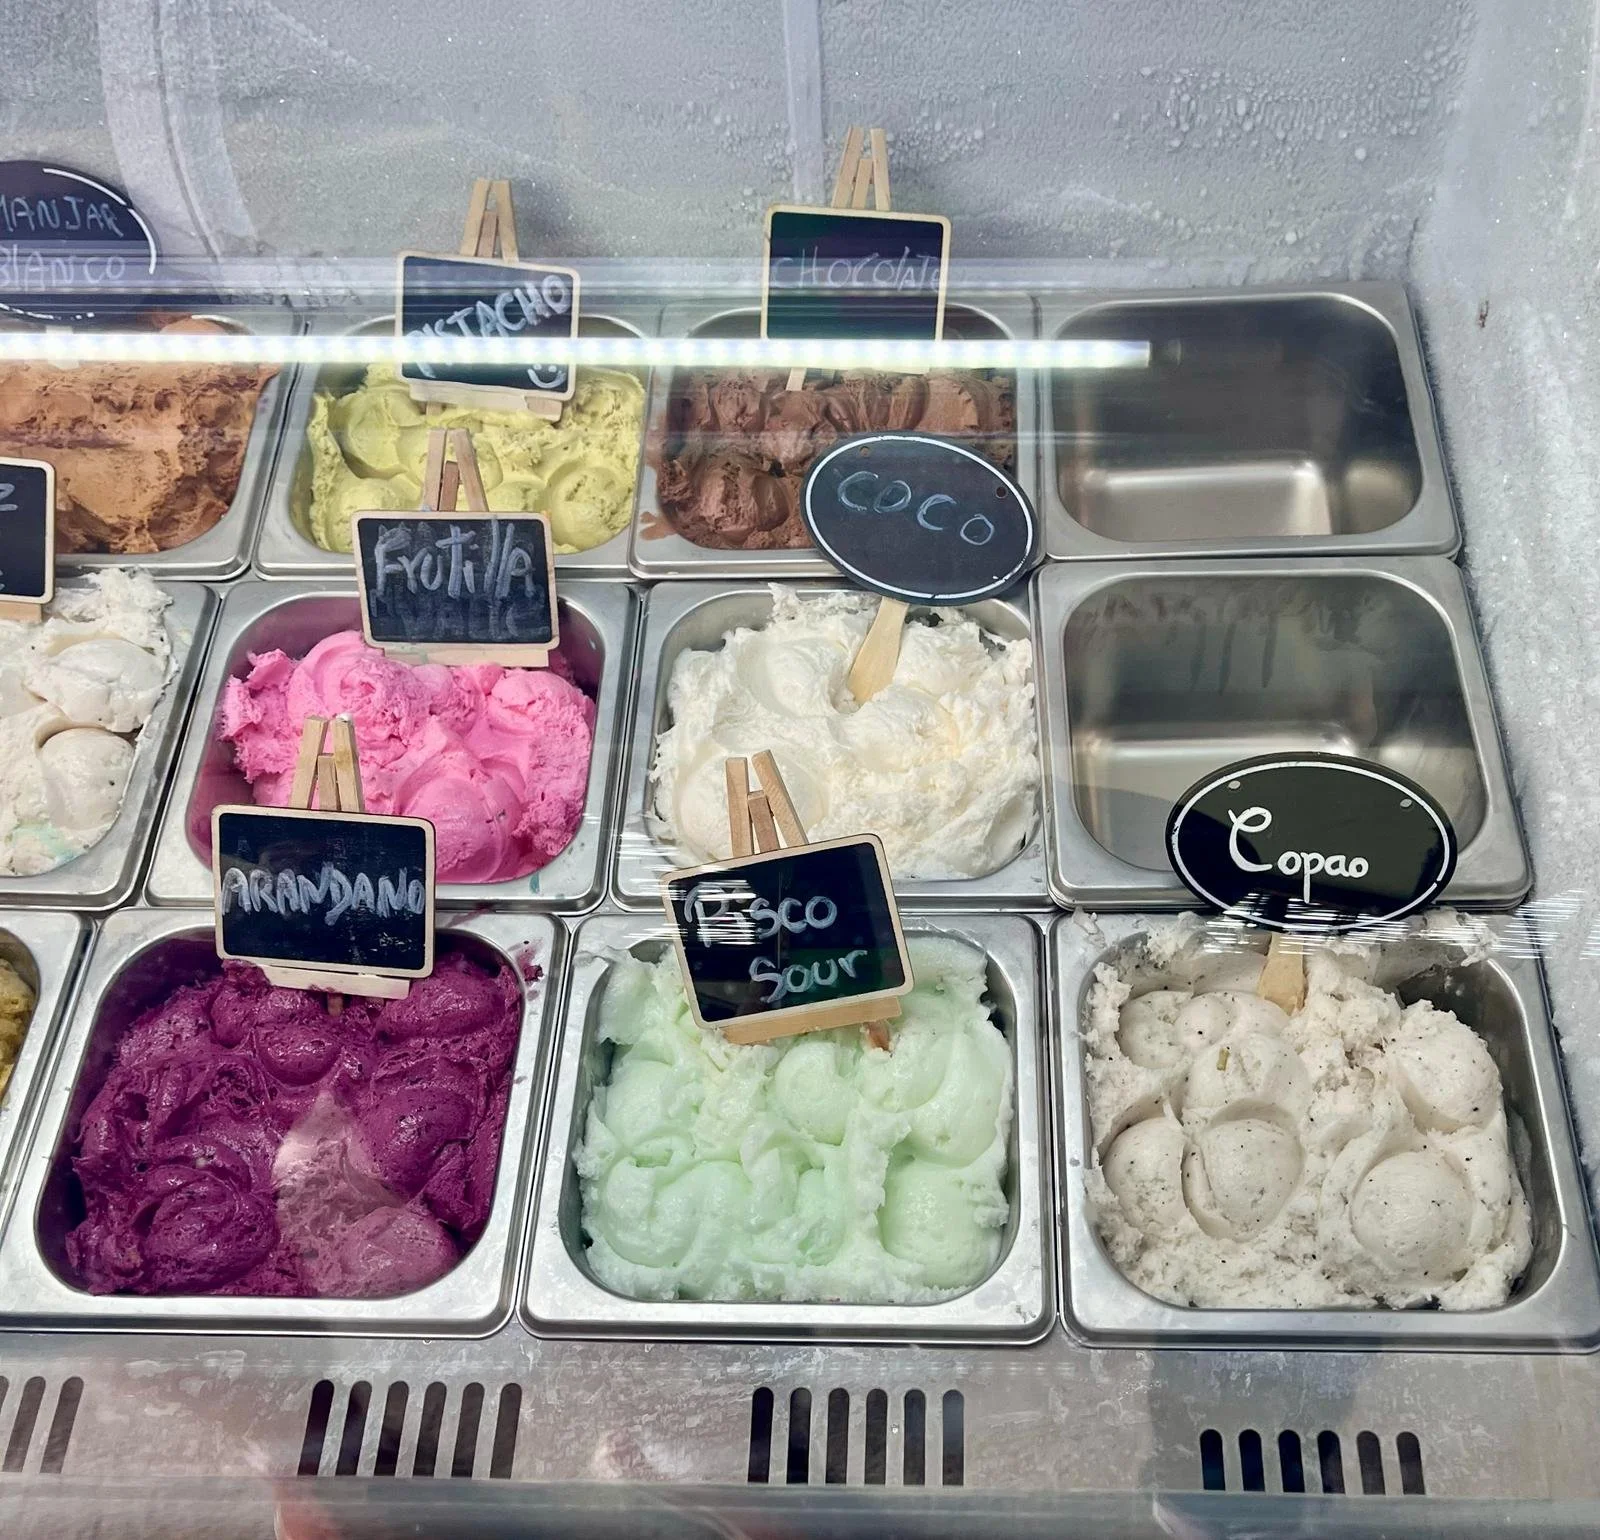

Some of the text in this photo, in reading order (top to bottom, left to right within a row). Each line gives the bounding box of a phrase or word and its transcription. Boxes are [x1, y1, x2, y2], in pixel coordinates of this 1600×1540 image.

[1228, 806, 1369, 903] Copao
[221, 862, 425, 926] ARANDANO
[684, 883, 837, 947] Pisco
[749, 950, 868, 1003] Sour
